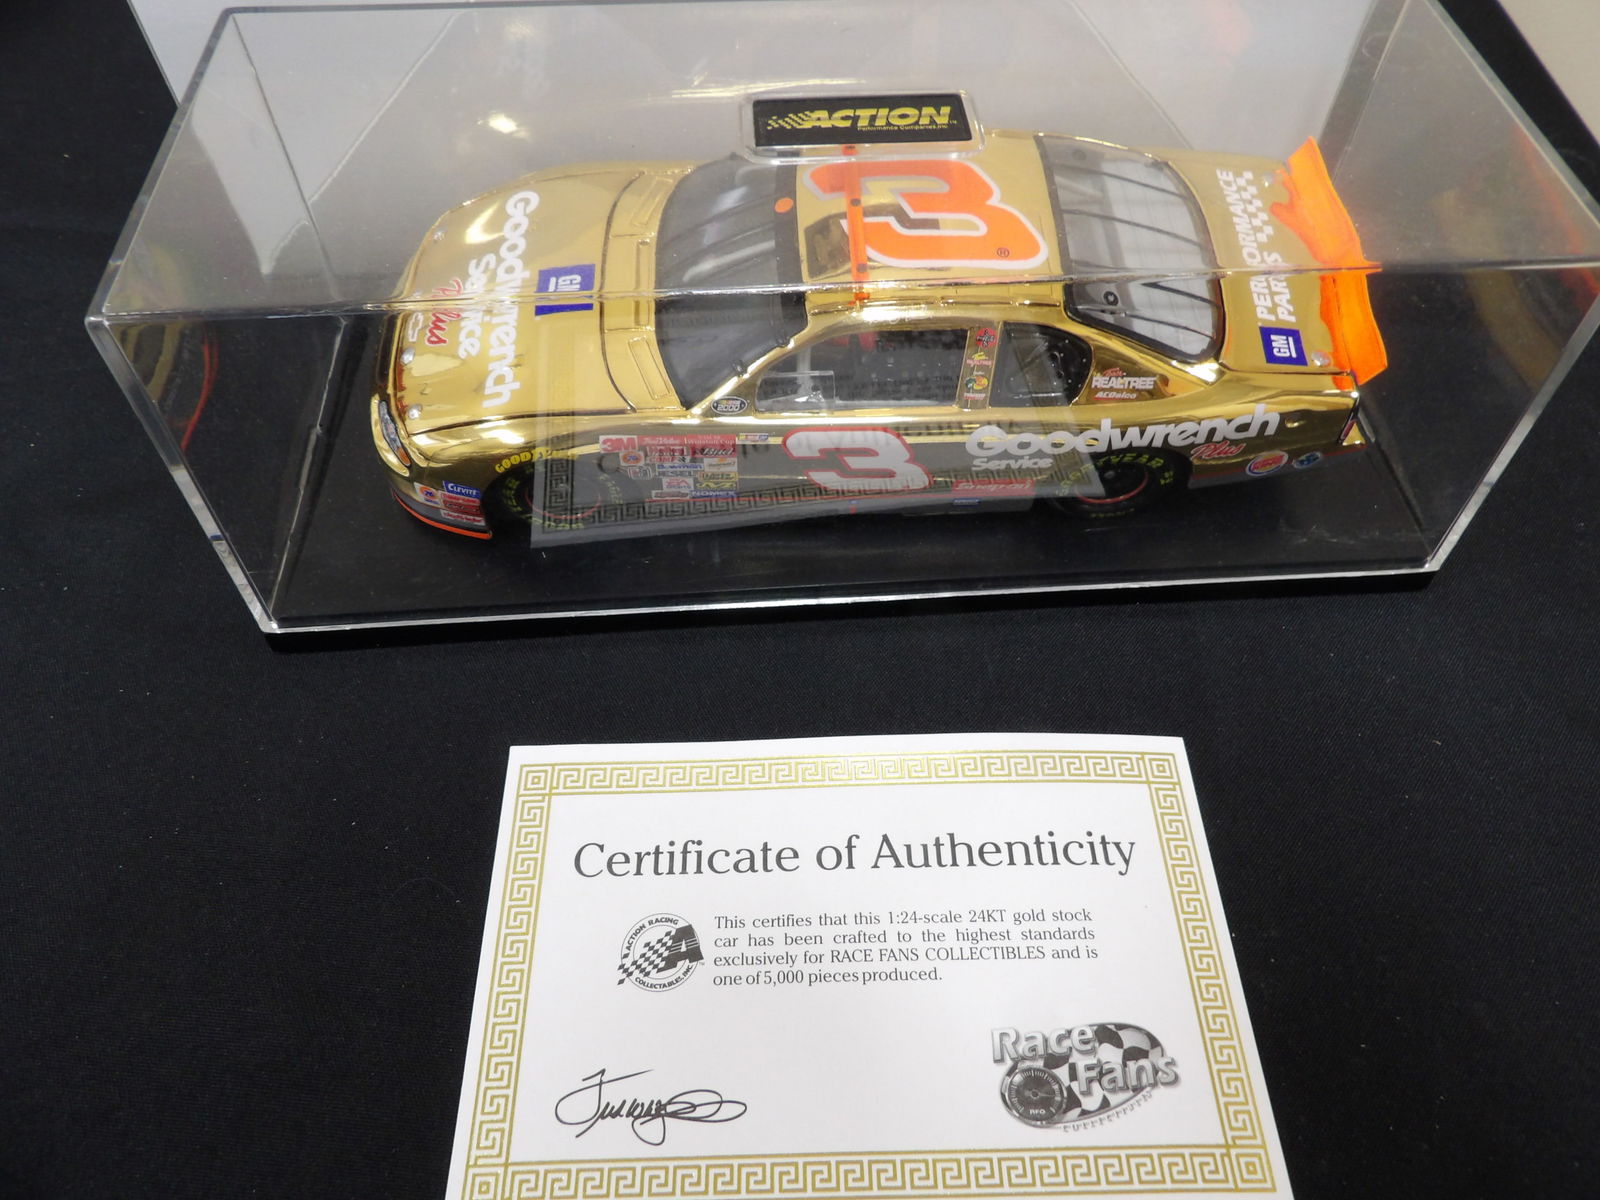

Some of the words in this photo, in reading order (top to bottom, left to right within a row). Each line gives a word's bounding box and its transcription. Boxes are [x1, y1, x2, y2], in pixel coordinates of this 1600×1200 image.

[797, 106, 951, 128] ACTION
[803, 159, 1048, 269] 3
[1216, 168, 1275, 322] PERORMANCE
[1265, 251, 1296, 323] PARS
[1270, 334, 1291, 358] GM
[1091, 376, 1156, 389] REALTREE
[965, 403, 1280, 457] Goodwrench
[601, 437, 637, 452] 3M
[1190, 440, 1247, 459] Plus
[782, 426, 935, 492] 3
[972, 456, 1053, 471] Service
[574, 840, 800, 878] Certificate
[816, 834, 861, 871] of
[871, 831, 1136, 876] Authenticity
[714, 915, 746, 929] This
[753, 914, 812, 928] certifies
[819, 912, 848, 926] that
[854, 911, 881, 925] this
[888, 910, 963, 925] 1:24-scale
[968, 908, 1007, 922] 24KT
[1013, 908, 1046, 925] gold
[1052, 908, 1093, 922] stock
[626, 923, 646, 951] ACTION
[648, 917, 679, 926] RACING
[714, 937, 739, 947] car
[748, 933, 775, 946] has
[785, 932, 823, 945] been
[832, 930, 888, 944] crafted
[897, 930, 912, 942] to
[922, 929, 946, 942] the
[956, 928, 1011, 945] highest
[1021, 927, 1096, 941] standards
[714, 951, 798, 968] exclusively
[804, 950, 825, 964] for
[831, 949, 874, 963] RACE
[879, 948, 920, 962] FANS
[925, 946, 1046, 961] COLLECTIBLES
[1052, 945, 1081, 959] and
[1086, 945, 1099, 959] is
[713, 974, 743, 986] one
[746, 971, 762, 985] of
[763, 970, 804, 987] 5,000
[808, 970, 859, 987] pieces
[862, 966, 943, 985] produced.
[991, 1023, 1099, 1063] Race
[1075, 1056, 1182, 1095] Fans
